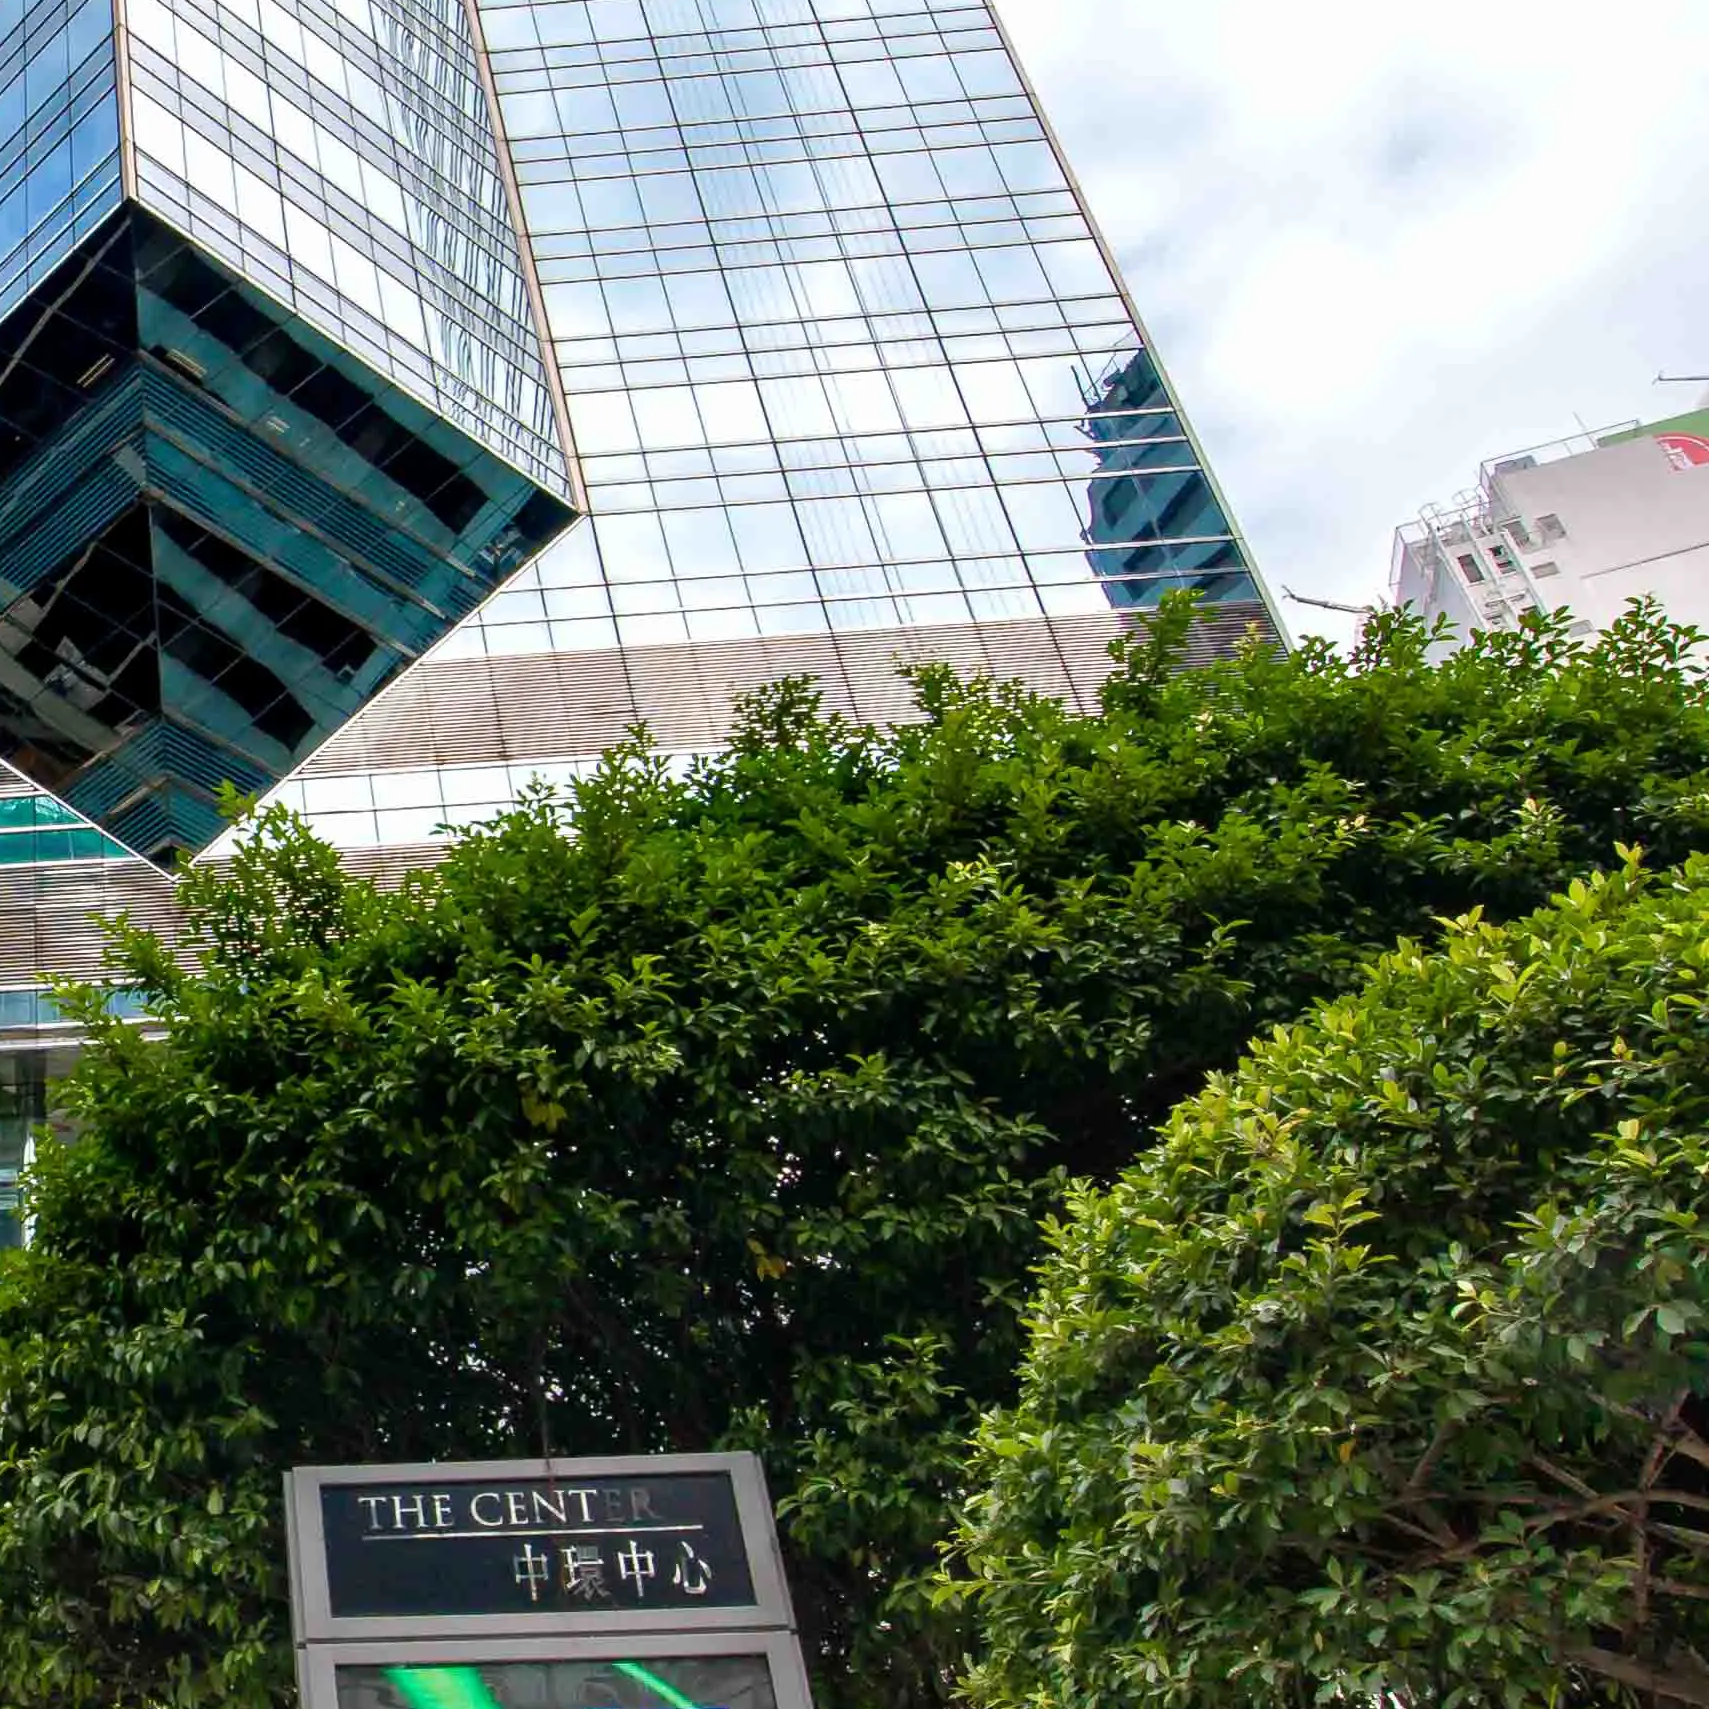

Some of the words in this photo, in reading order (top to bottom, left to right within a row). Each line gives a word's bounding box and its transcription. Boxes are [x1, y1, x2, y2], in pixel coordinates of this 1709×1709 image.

[357, 1493, 455, 1531] THE
[469, 1487, 665, 1528] CENTER
[513, 1539, 715, 1603] 中環中心
